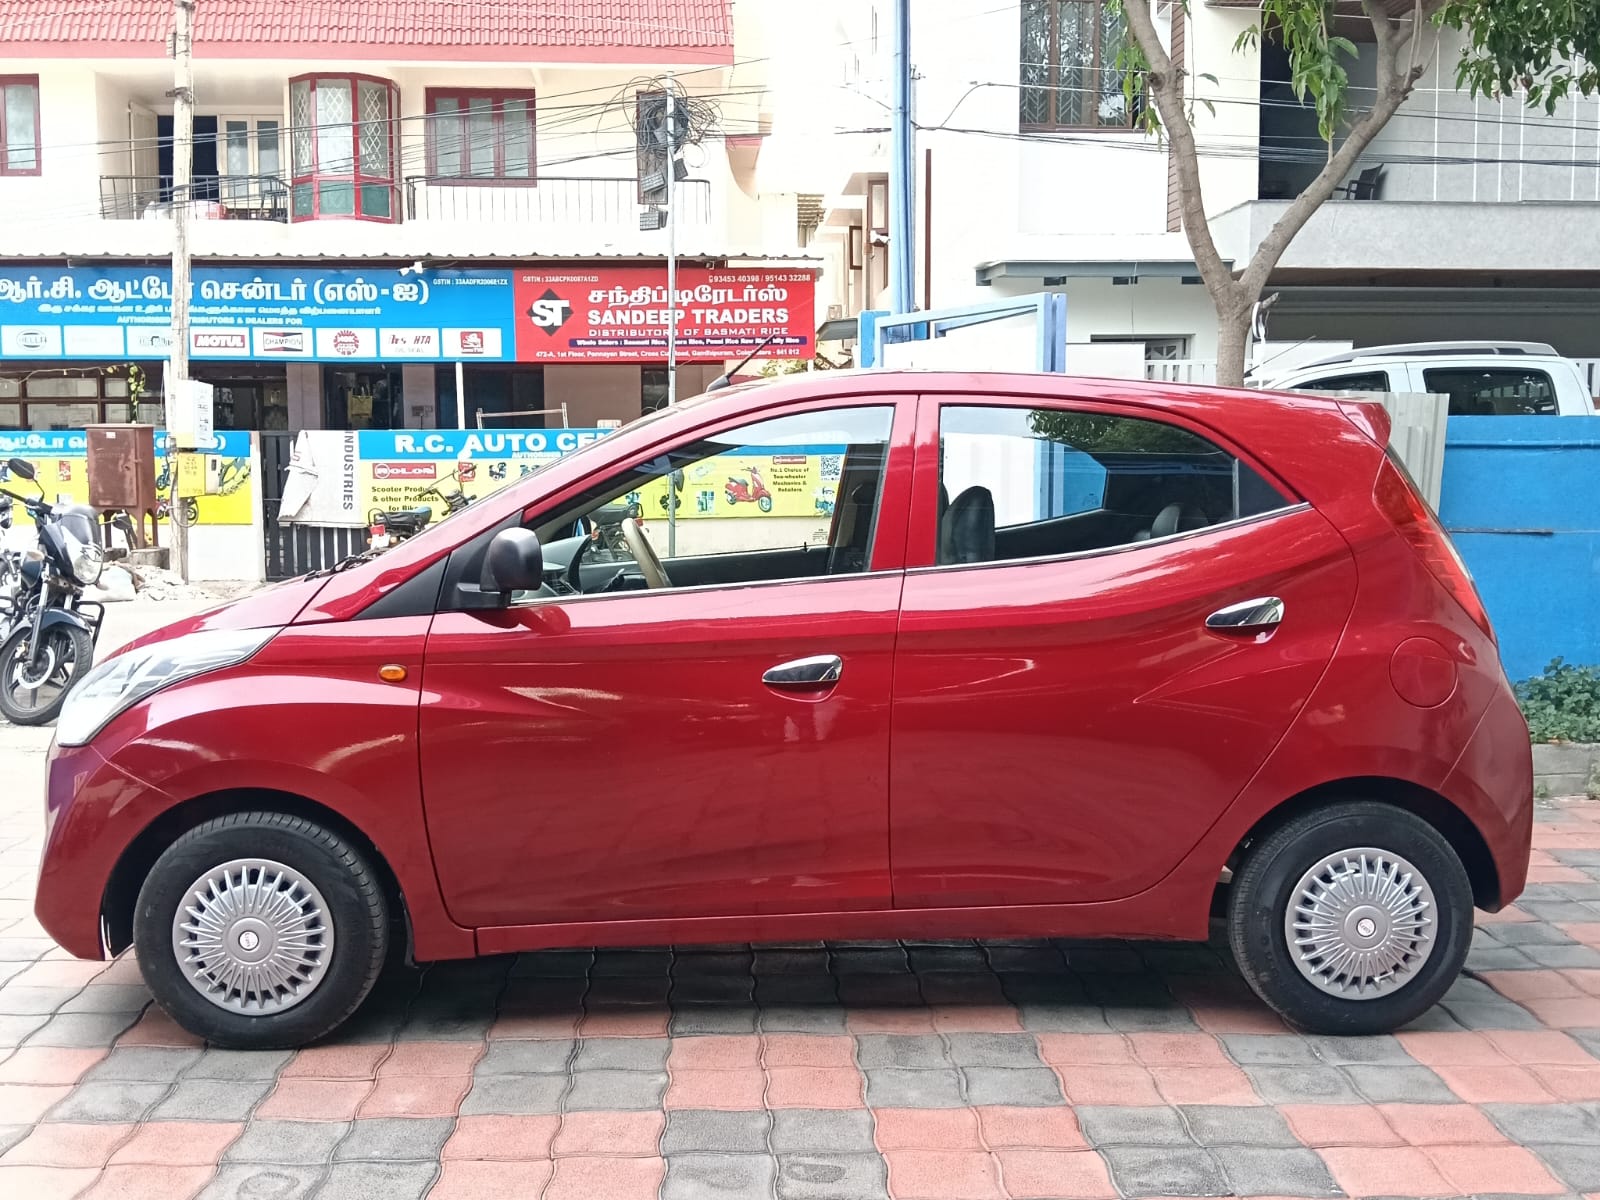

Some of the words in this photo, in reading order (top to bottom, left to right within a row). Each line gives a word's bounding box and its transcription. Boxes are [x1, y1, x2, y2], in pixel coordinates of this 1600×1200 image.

[201, 276, 307, 301] சென்டர்
[531, 299, 570, 327] ST
[588, 309, 685, 325] SANDEEP
[691, 308, 789, 324] TRADERS
[588, 328, 679, 337] DISTRIBUTORS
[684, 328, 700, 336] OF
[704, 328, 756, 336] BASMATI
[760, 327, 789, 335] RICE
[196, 335, 245, 348] MOTUL
[264, 337, 303, 346] CHAMPION
[394, 434, 454, 453] R.C.
[463, 433, 547, 453] AUTO
[342, 431, 354, 511] INDUSTRIES
